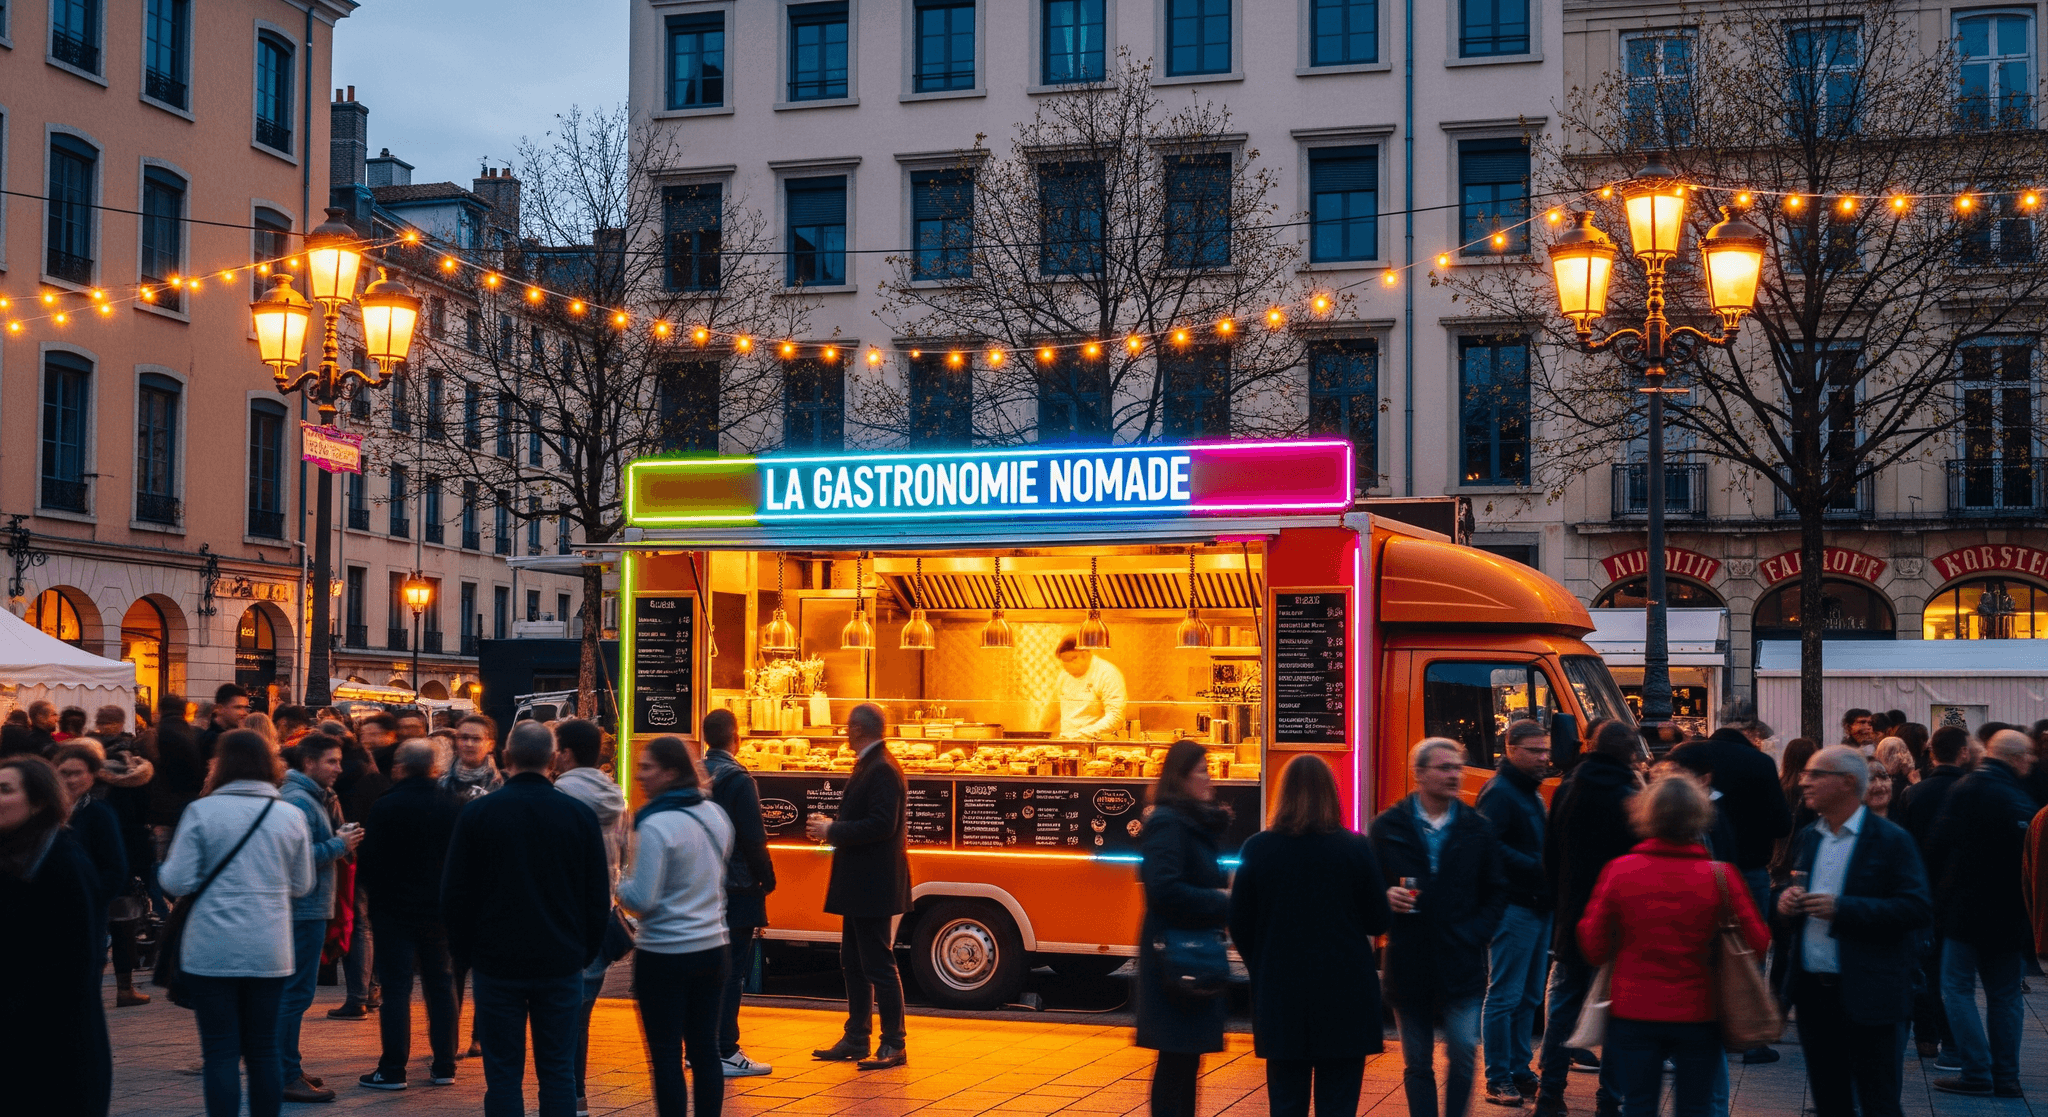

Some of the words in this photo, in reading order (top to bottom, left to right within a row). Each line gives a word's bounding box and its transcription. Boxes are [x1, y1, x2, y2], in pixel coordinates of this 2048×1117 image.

[767, 468, 805, 510] LA
[813, 460, 1039, 509] GASTRONOMIE
[1050, 456, 1191, 503] NOMADE
